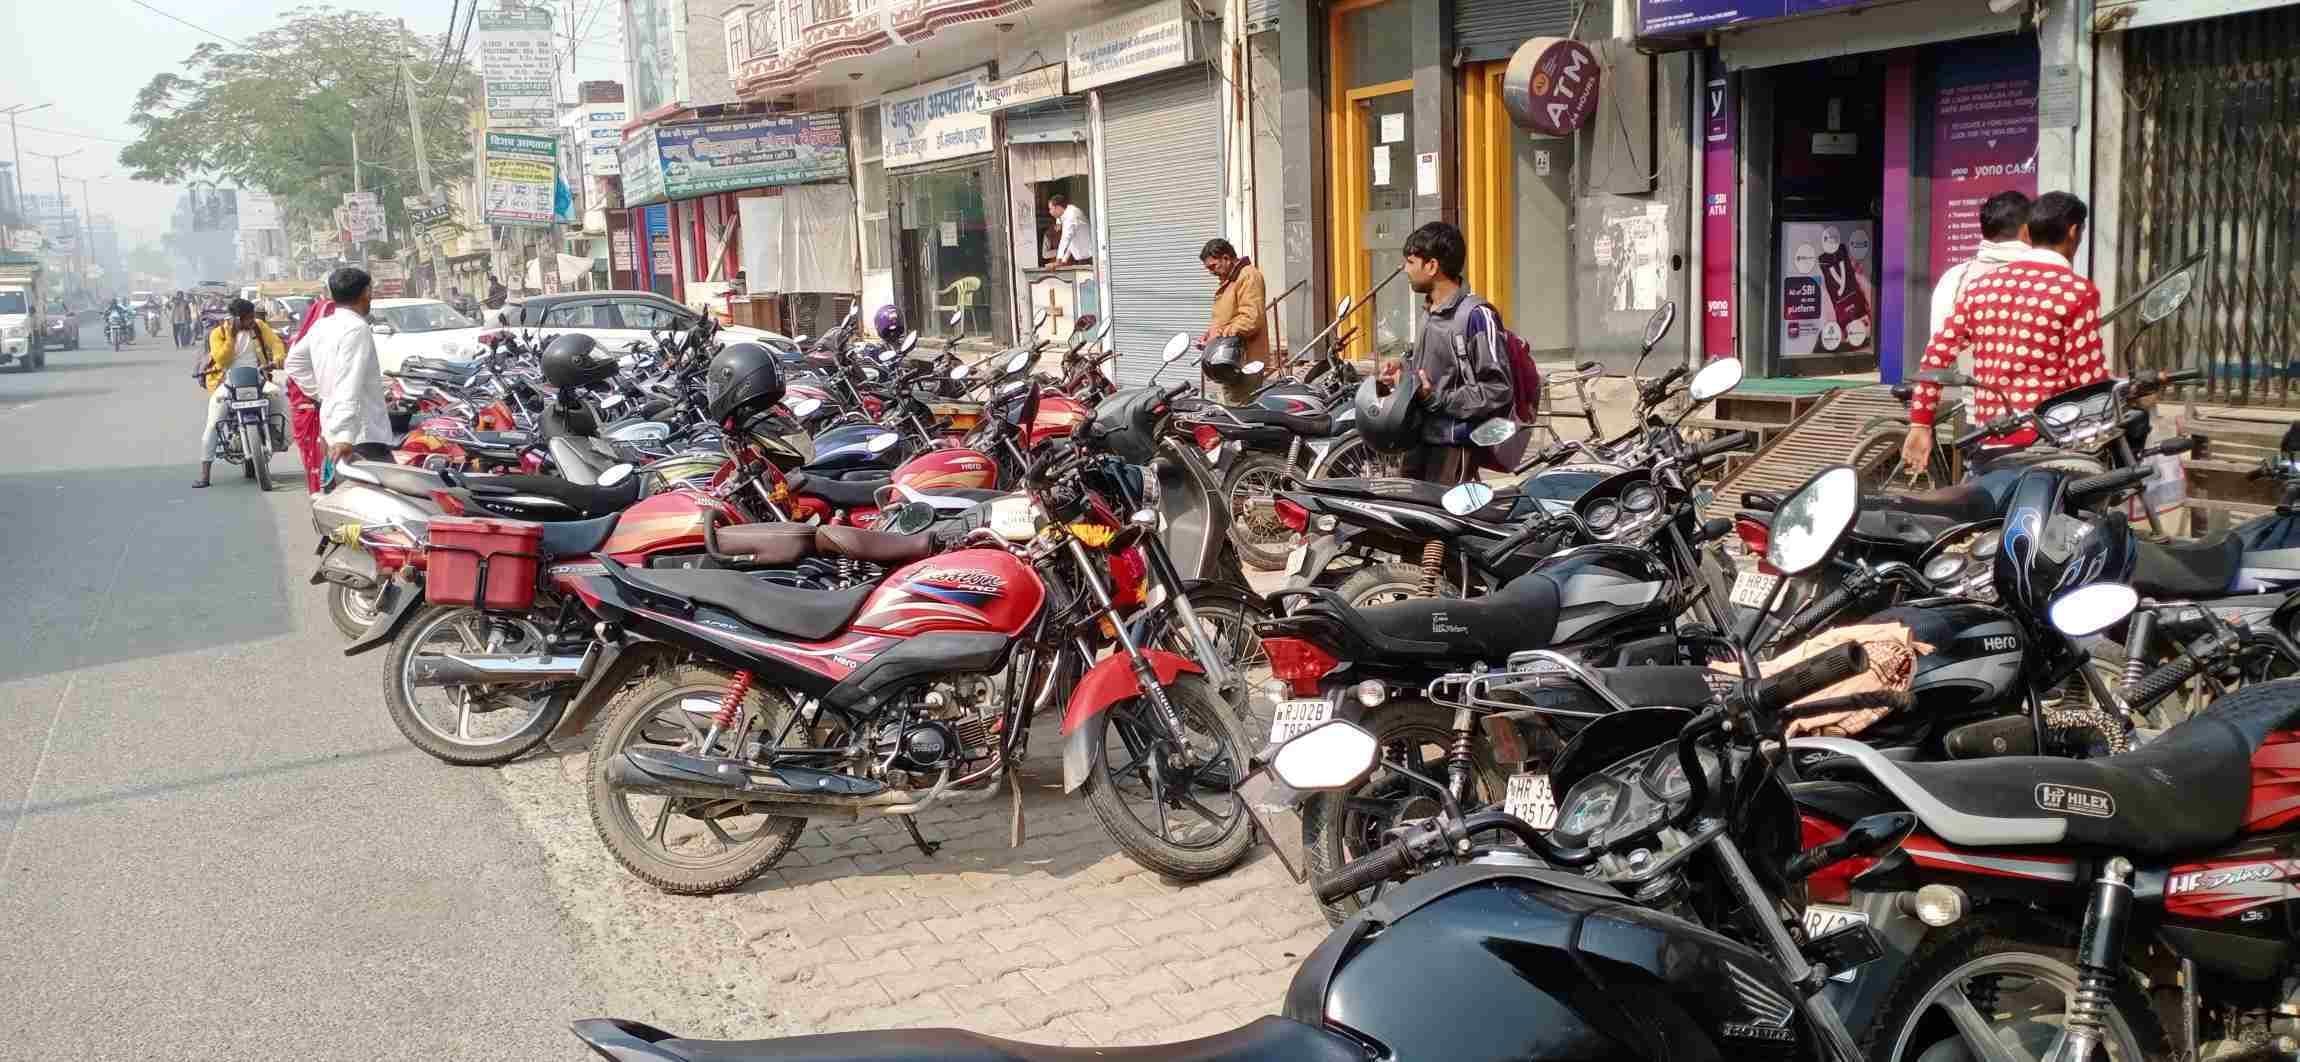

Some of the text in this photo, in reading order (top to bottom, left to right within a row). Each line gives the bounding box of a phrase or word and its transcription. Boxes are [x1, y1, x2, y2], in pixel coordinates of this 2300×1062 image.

[1546, 49, 1588, 128] ATM
[1975, 163, 2003, 180] yono
[1708, 205, 1727, 216] ATM
[1708, 300, 1728, 312] yono
[1787, 303, 1815, 315] platform
[1983, 636, 2017, 651] Hero
[832, 655, 857, 669] Hero
[1286, 703, 1324, 721] RJ02B
[2067, 791, 2110, 810] HILEX
[2170, 864, 2275, 894] HF Deluxe
